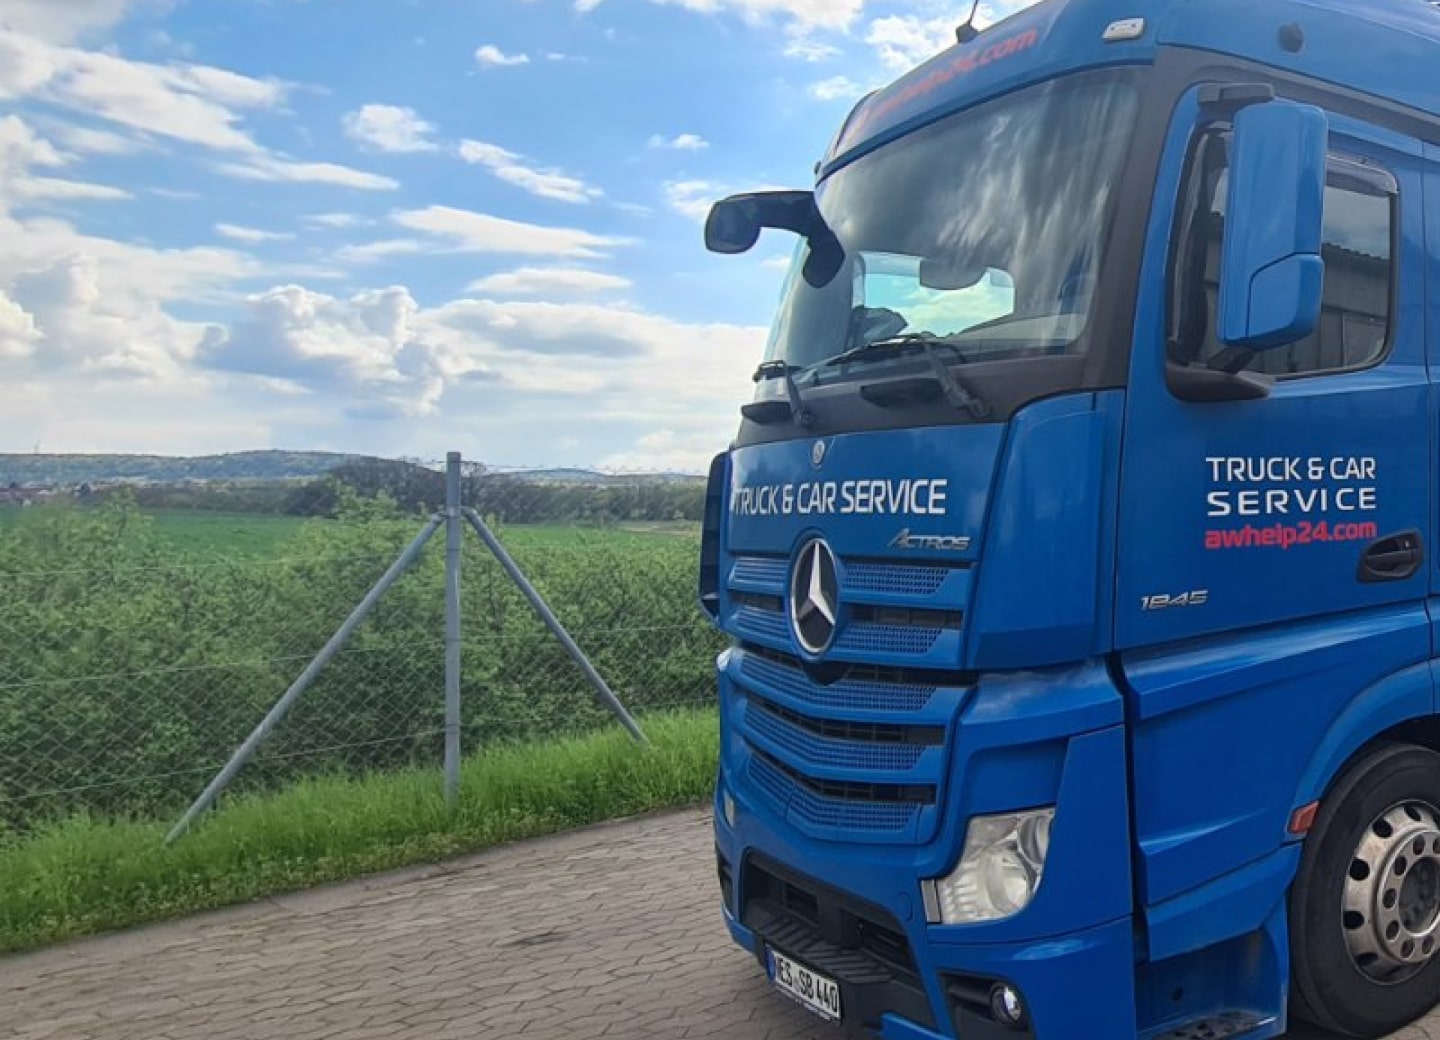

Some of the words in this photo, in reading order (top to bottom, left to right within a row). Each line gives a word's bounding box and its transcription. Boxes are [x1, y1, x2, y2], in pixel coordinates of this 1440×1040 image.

[1205, 456, 1302, 482] TRUCK
[1307, 456, 1326, 480] &
[1329, 456, 1376, 480] CAR
[731, 486, 779, 516] TRUCK
[782, 483, 794, 515] &
[797, 481, 837, 515] CAR
[840, 479, 947, 515] SERVICE
[1206, 487, 1377, 516] SERVICE
[1204, 520, 1378, 550] awhelp24.com
[1140, 589, 1209, 611] 1845
